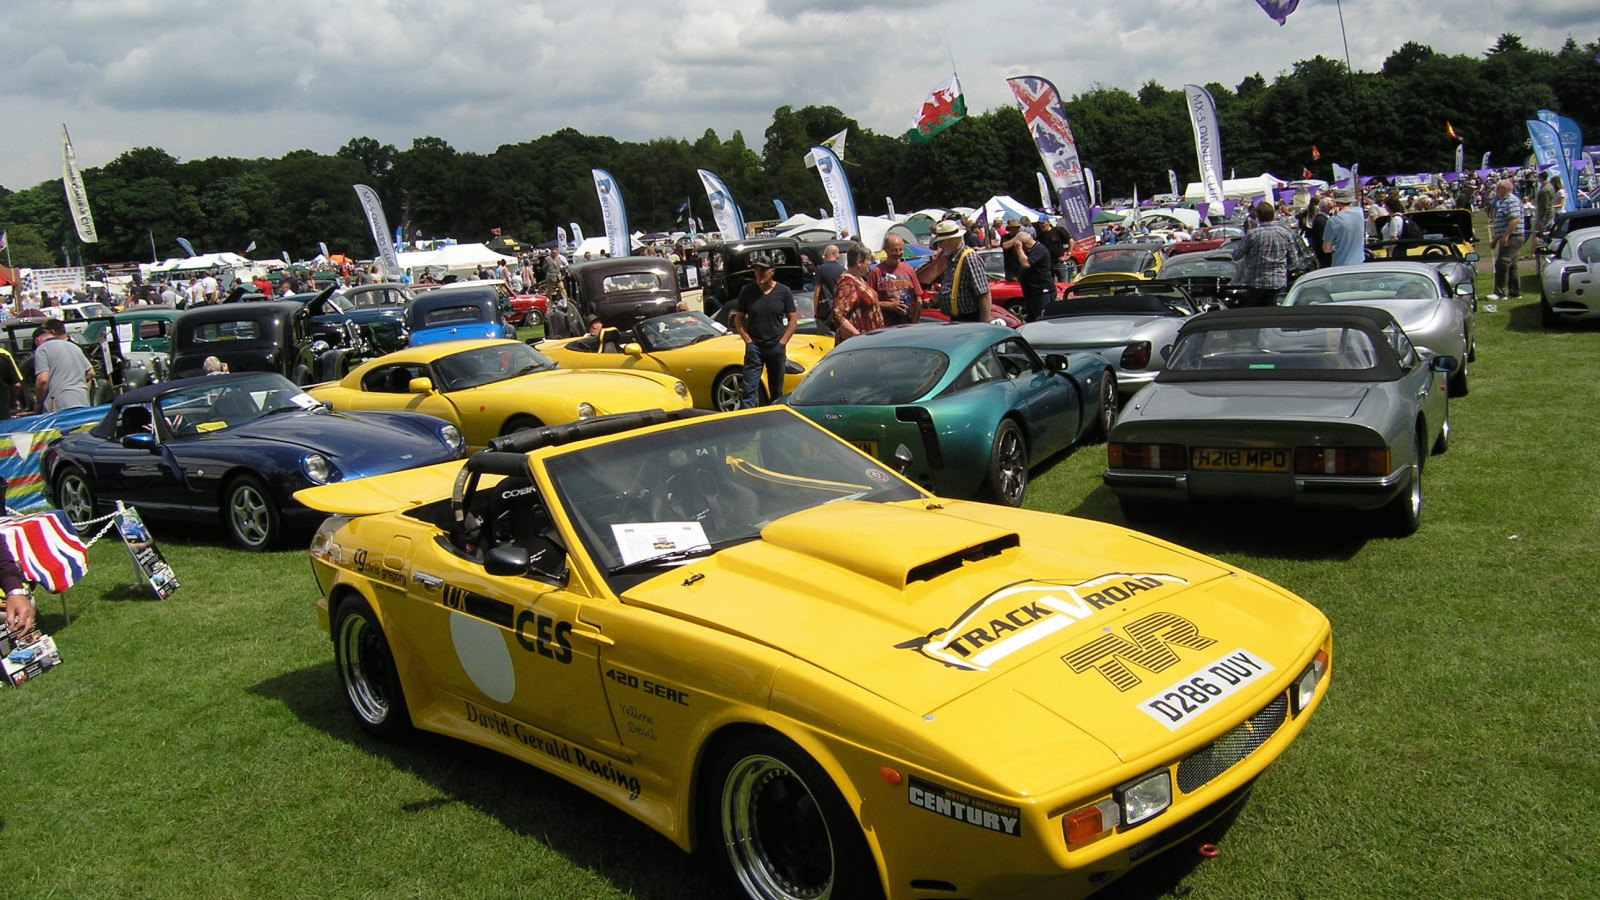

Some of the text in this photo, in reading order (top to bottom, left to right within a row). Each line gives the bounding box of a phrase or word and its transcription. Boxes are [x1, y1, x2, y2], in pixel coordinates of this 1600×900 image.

[1199, 125, 1213, 172] OWNERS
[371, 212, 387, 247] OWNERS
[382, 247, 394, 268] CLUB
[1198, 449, 1240, 467] H218
[365, 561, 407, 587] chris gregory
[447, 585, 471, 613] UK
[943, 601, 1054, 658] TRACK
[1082, 576, 1164, 610] ROAD
[515, 609, 573, 665] CES
[1060, 611, 1219, 693] TVR
[605, 668, 639, 689] 420
[1148, 652, 1263, 723] D286 DUY
[619, 702, 654, 726] Yellow
[627, 720, 658, 742] Devil
[464, 700, 642, 801] David Gerald Racing
[909, 786, 1018, 834] CENTURY
